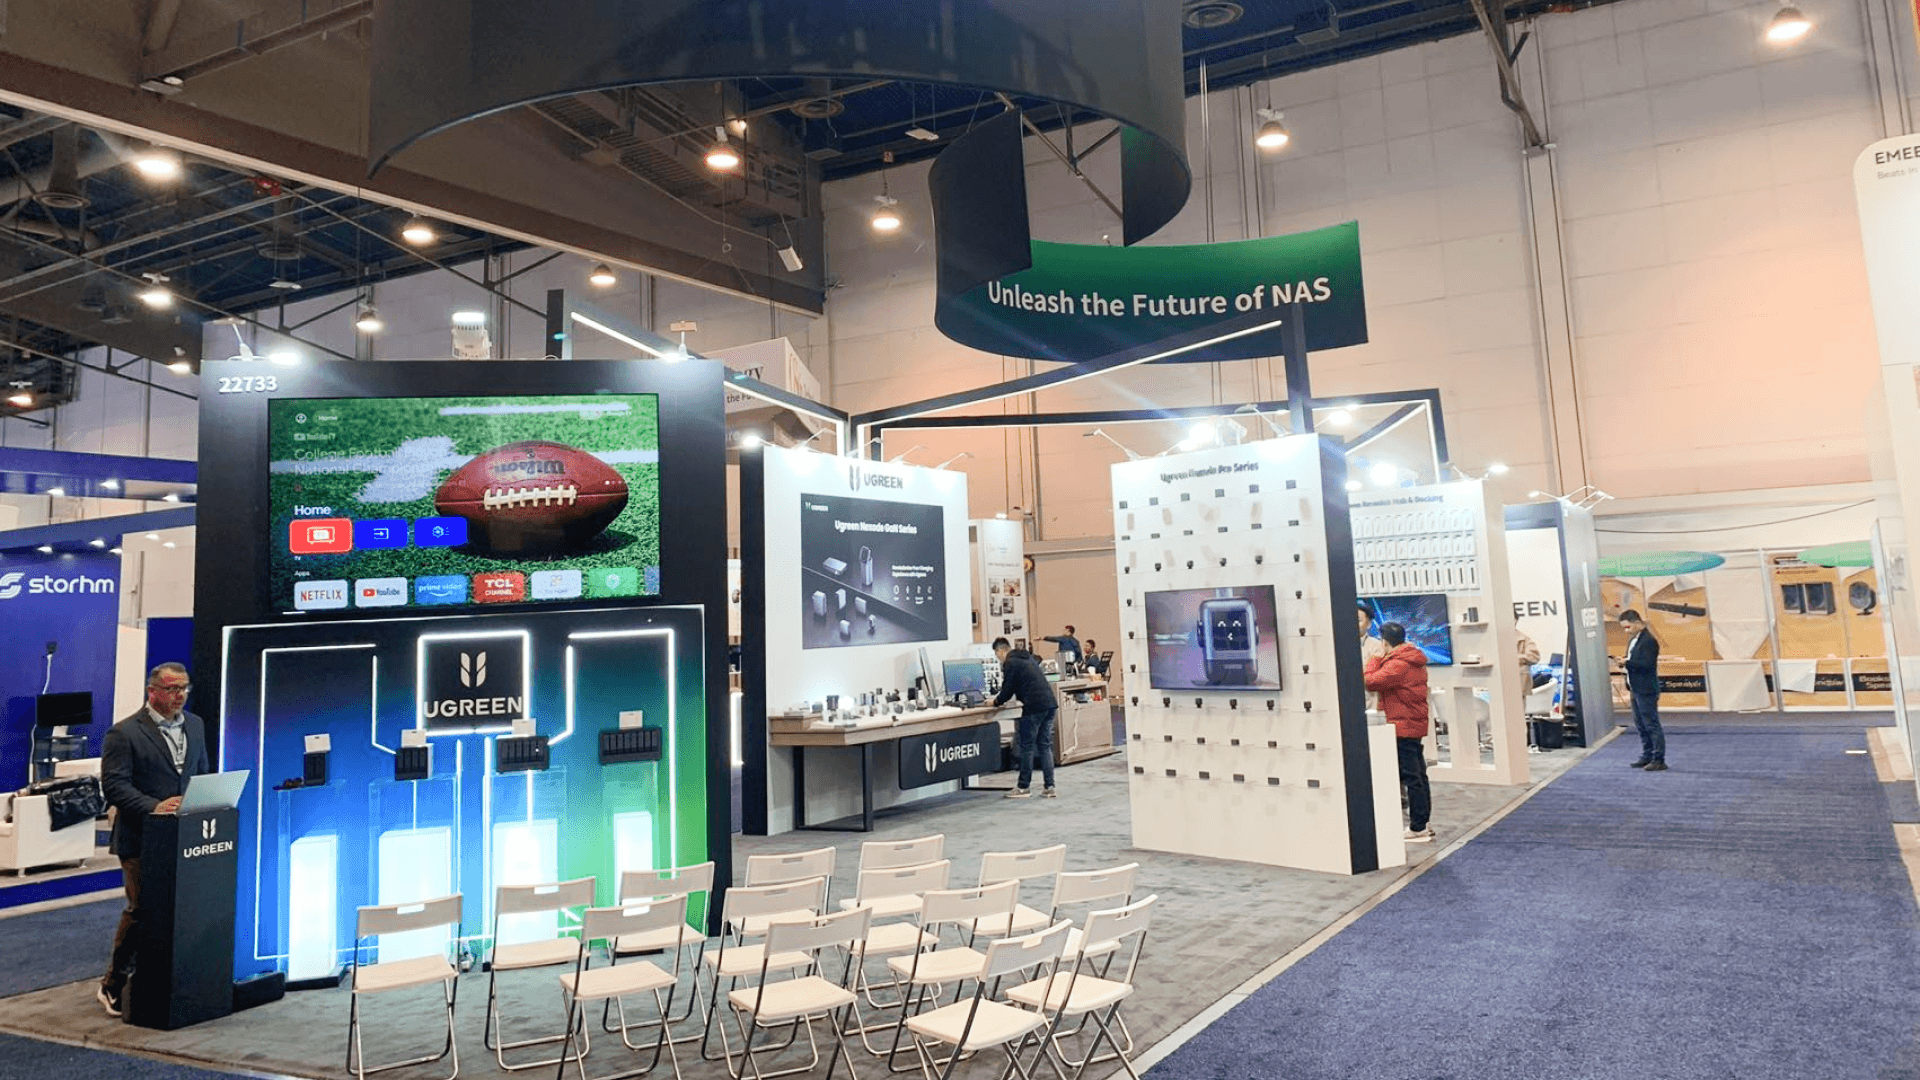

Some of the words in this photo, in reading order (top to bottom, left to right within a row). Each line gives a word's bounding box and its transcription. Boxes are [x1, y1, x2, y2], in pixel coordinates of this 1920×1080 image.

[987, 280, 1075, 315] Unleash
[1081, 292, 1125, 317] the
[1133, 293, 1227, 317] Future
[1234, 284, 1264, 312] of
[1271, 277, 1332, 307] NAS
[218, 375, 278, 393] 22733
[294, 448, 345, 462] College
[863, 473, 904, 489] UGREEN
[294, 504, 332, 516] Home
[28, 575, 115, 594] storhm
[484, 578, 514, 588] TCL
[300, 588, 343, 602] NETFLIX
[376, 587, 401, 597] YouTube
[424, 696, 524, 720] UGREEN
[940, 742, 980, 763] UGREEN
[183, 840, 234, 859] UGREEN
